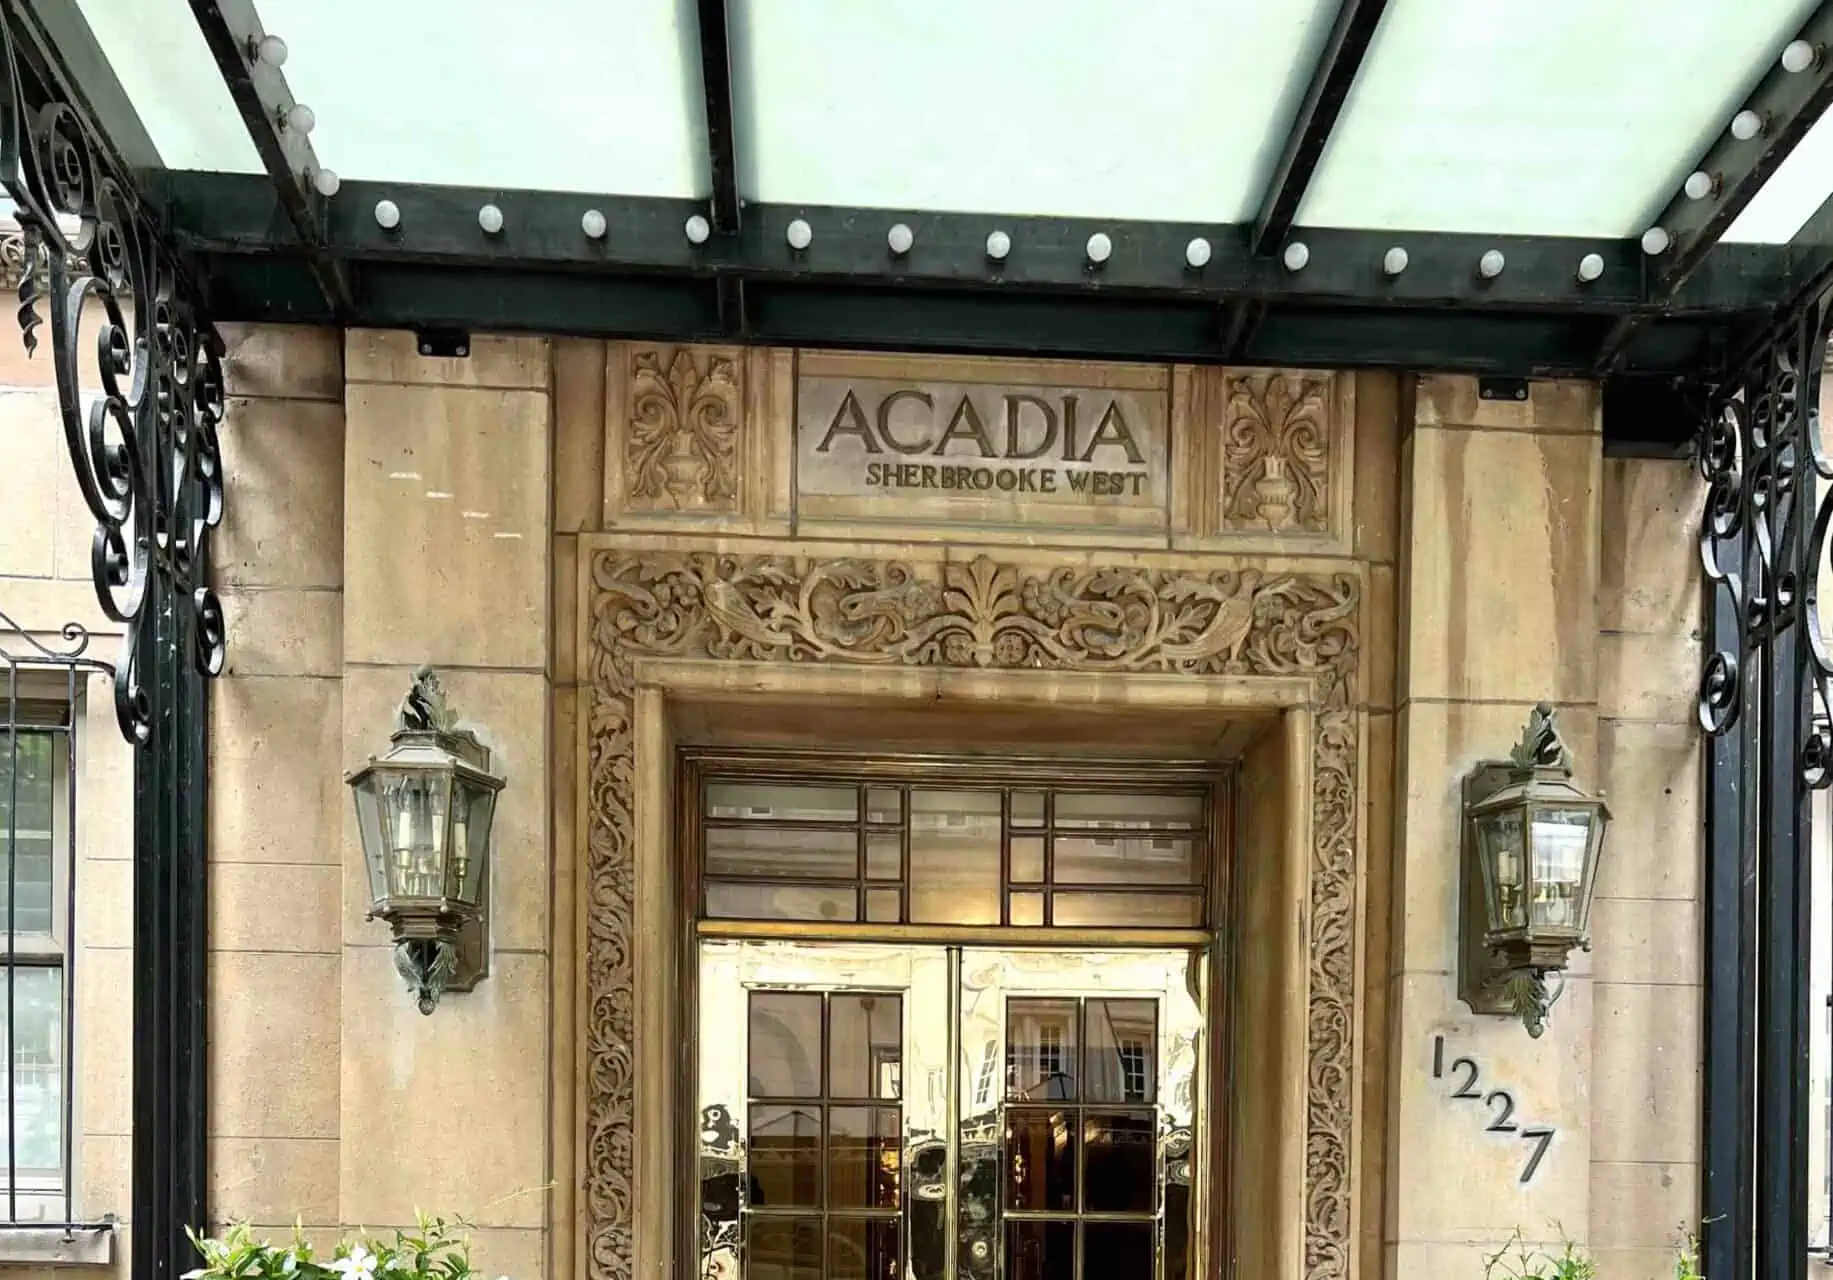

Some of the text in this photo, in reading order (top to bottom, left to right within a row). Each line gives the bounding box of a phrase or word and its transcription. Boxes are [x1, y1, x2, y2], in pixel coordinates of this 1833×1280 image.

[816, 388, 1146, 464] ACADIA
[865, 463, 1148, 497] SHERBROOKE WEST
[1433, 1035, 1556, 1183] 1227
